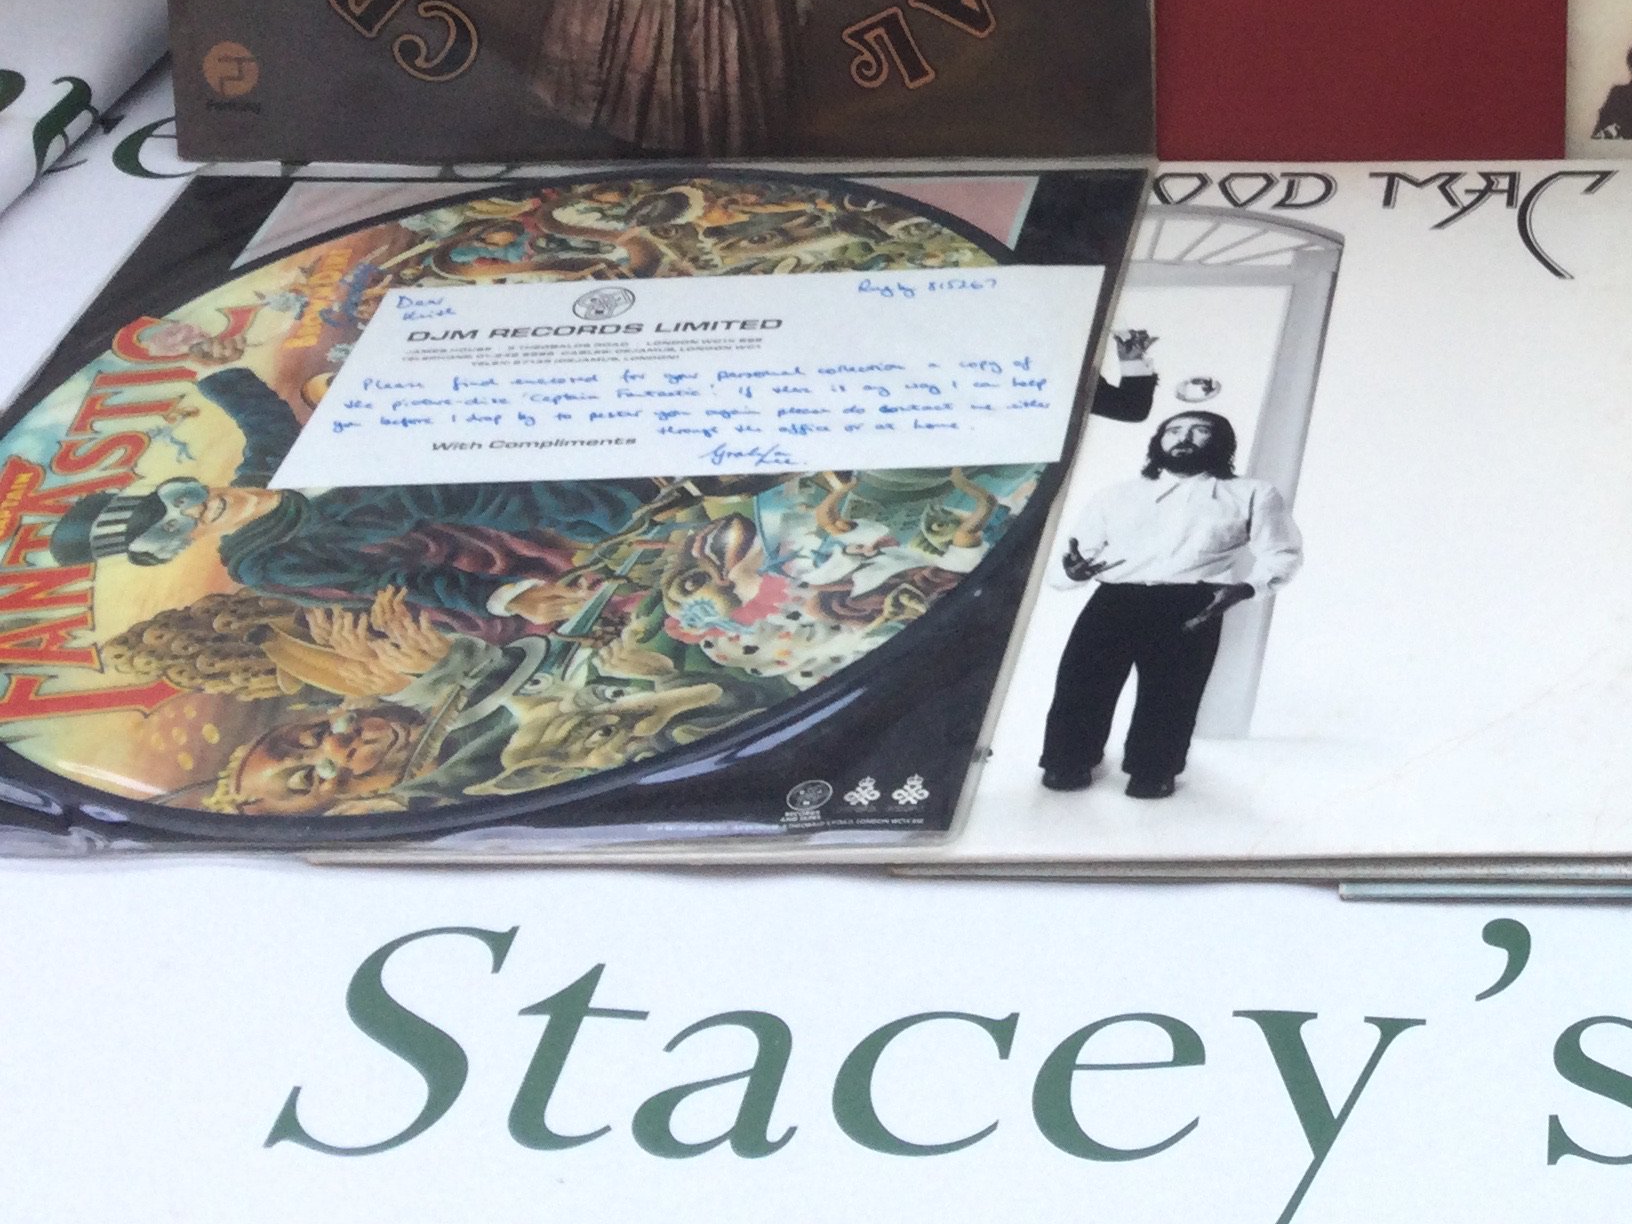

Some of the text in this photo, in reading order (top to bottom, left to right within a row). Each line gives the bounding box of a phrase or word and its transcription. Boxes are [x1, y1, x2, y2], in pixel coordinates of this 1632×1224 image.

[1368, 169, 1620, 280] MAC
[406, 319, 784, 342] DJM RECORDS LIMITED
[958, 359, 1003, 375] copy
[1012, 356, 1033, 371] of
[431, 437, 637, 452] With Compliments
